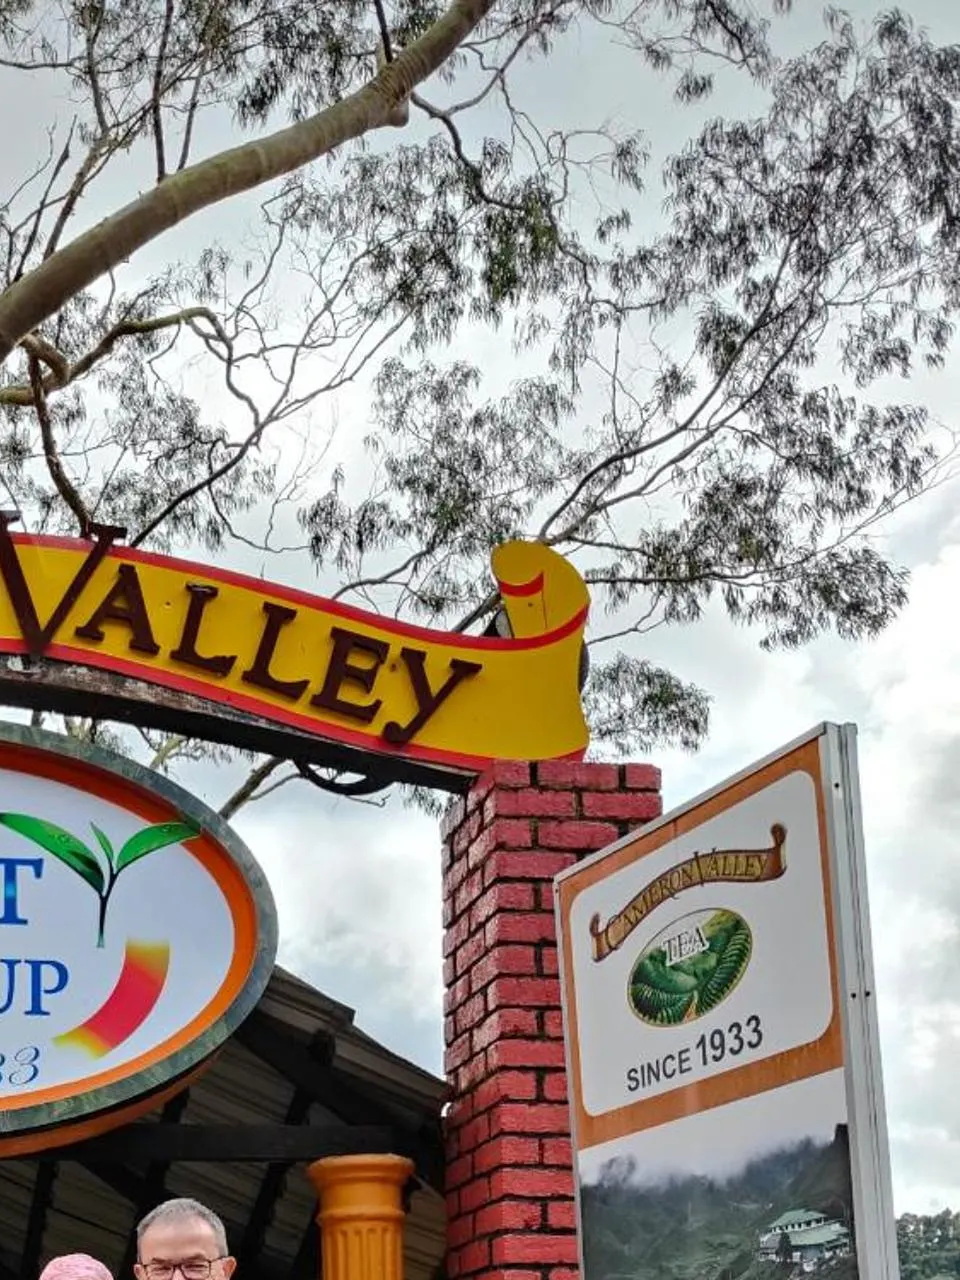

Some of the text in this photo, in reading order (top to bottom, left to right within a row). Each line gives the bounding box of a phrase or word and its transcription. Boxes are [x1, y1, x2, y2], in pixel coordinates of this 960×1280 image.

[605, 847, 769, 951] CAMERON VALLEY
[662, 925, 708, 964] TEA
[627, 1013, 763, 1093] SINCE 1933
